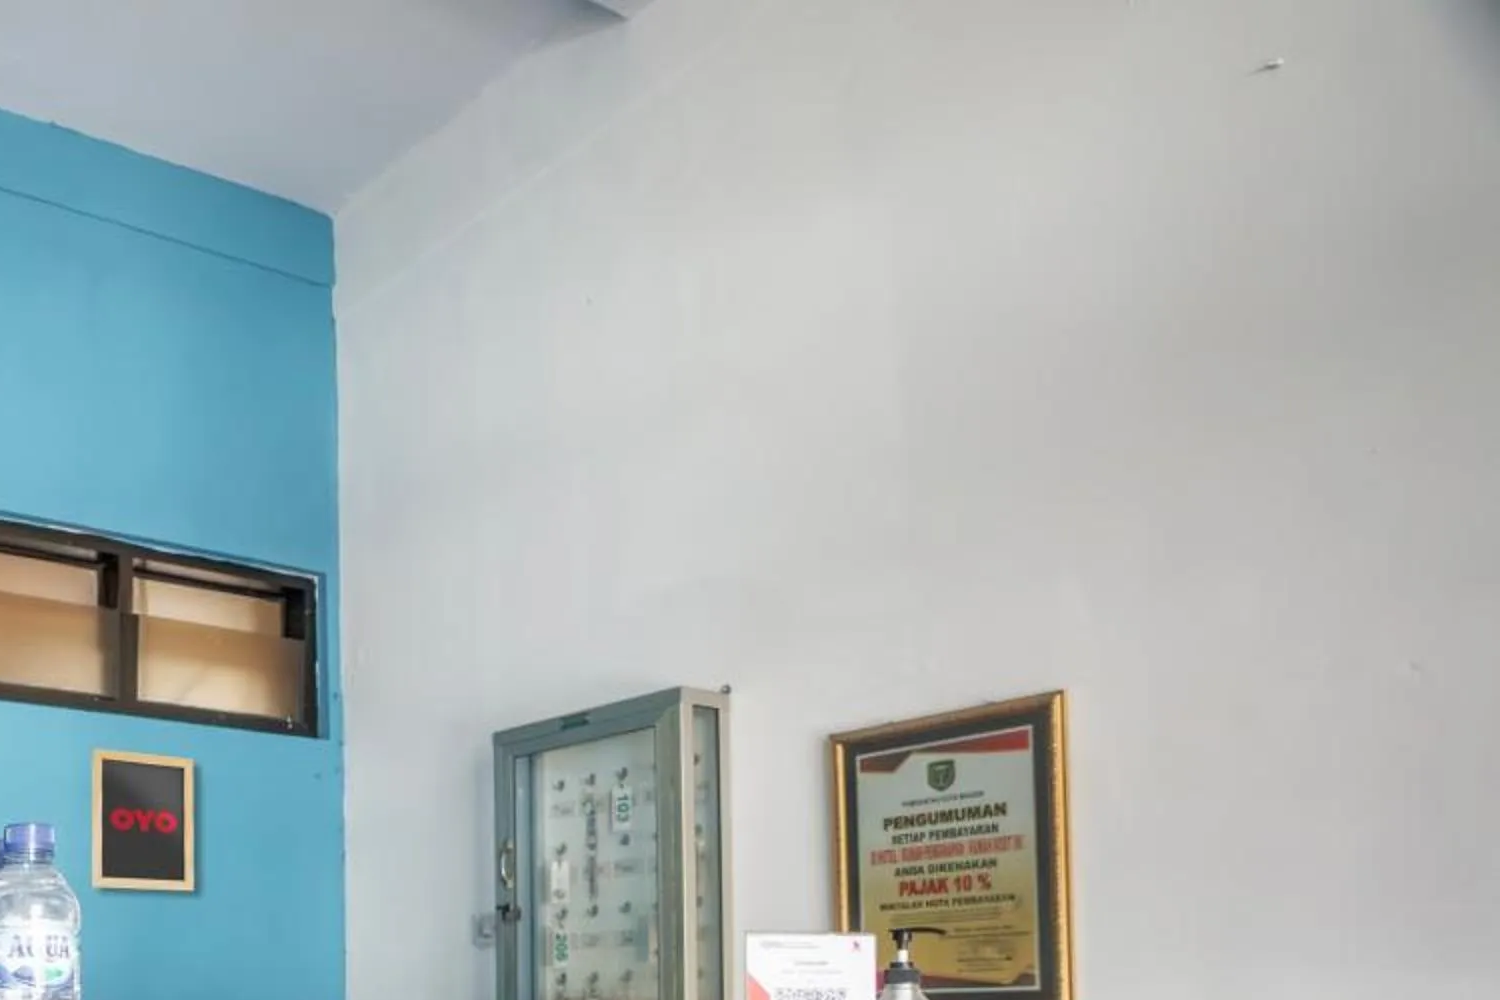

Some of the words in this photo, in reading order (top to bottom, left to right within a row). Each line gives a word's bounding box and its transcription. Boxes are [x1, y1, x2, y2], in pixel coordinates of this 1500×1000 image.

[108, 807, 179, 834] OYO
[883, 802, 1008, 831] PENGUMUMAN
[898, 877, 949, 897] PAJAK
[953, 875, 973, 892] 10
[977, 873, 992, 891] %
